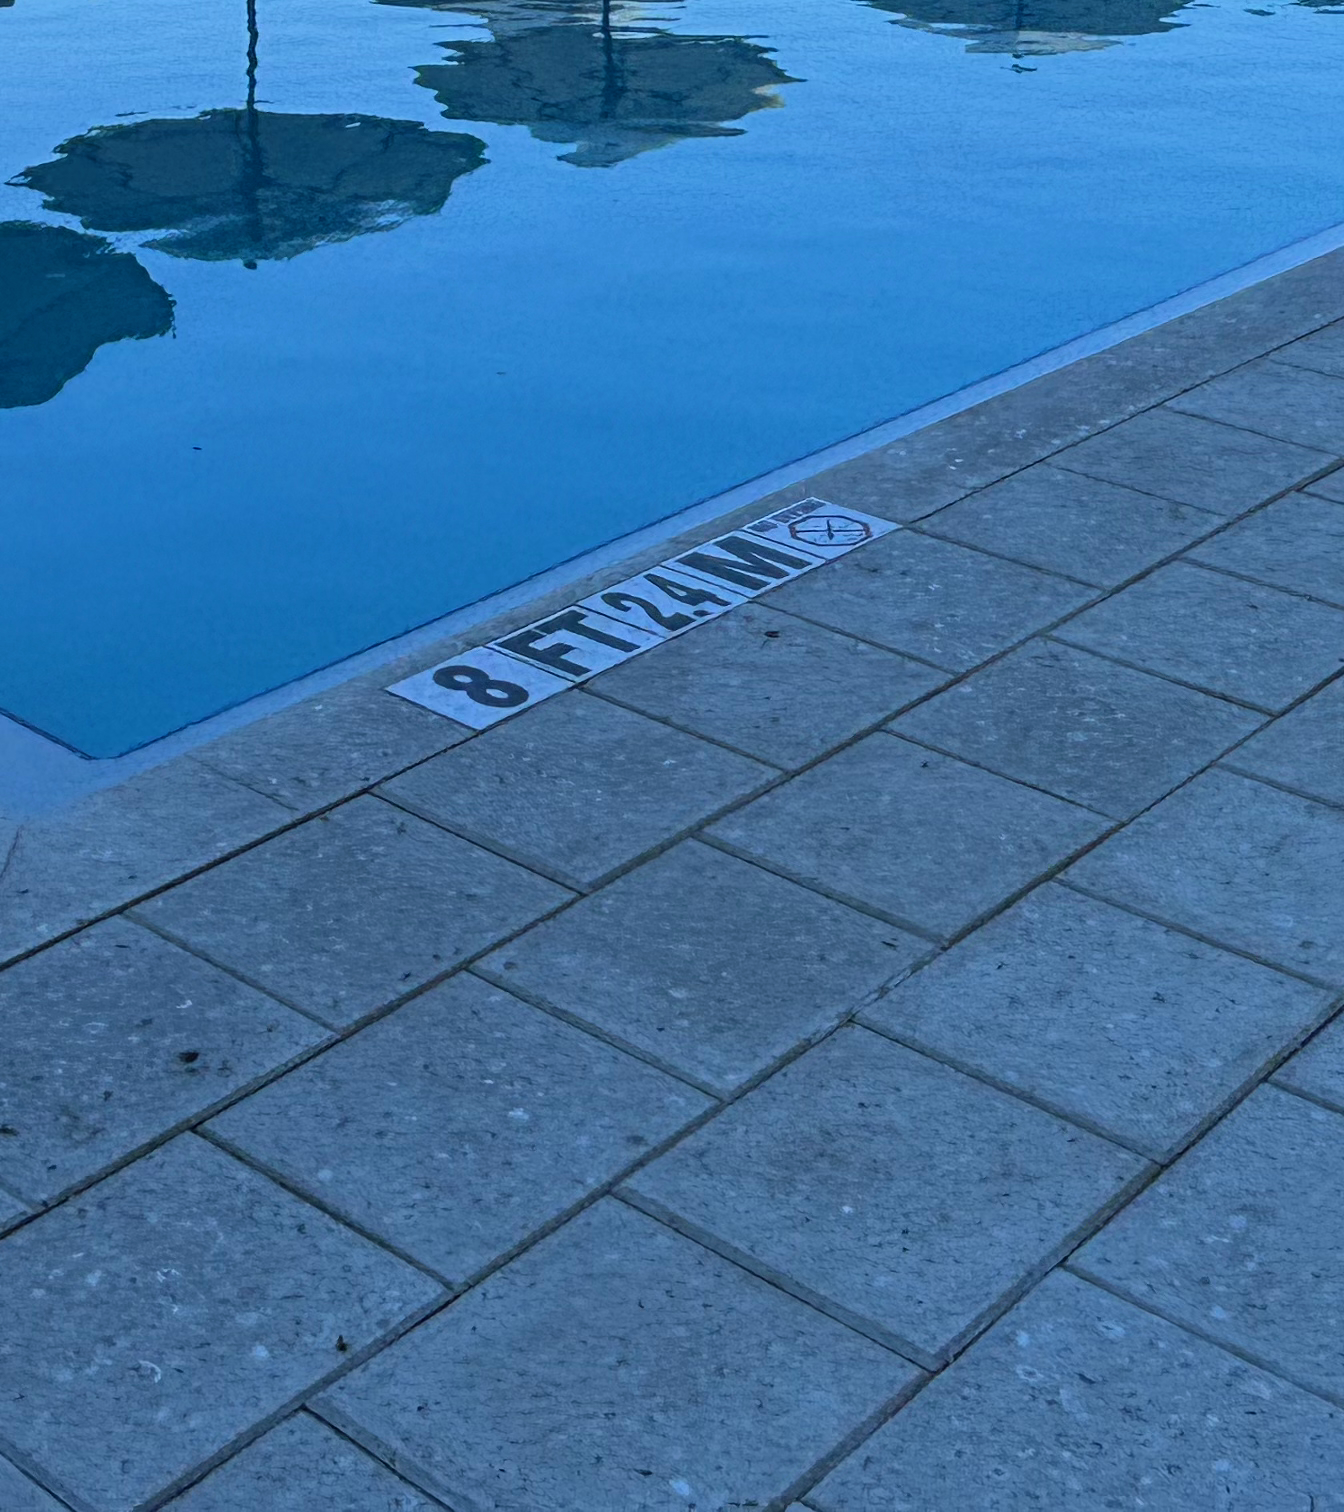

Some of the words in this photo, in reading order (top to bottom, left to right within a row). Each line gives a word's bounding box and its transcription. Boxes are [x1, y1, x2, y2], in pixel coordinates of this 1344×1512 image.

[432, 664, 529, 708] 8
[494, 608, 641, 677] FT
[600, 573, 734, 633] 2.4
[675, 535, 814, 591] M
